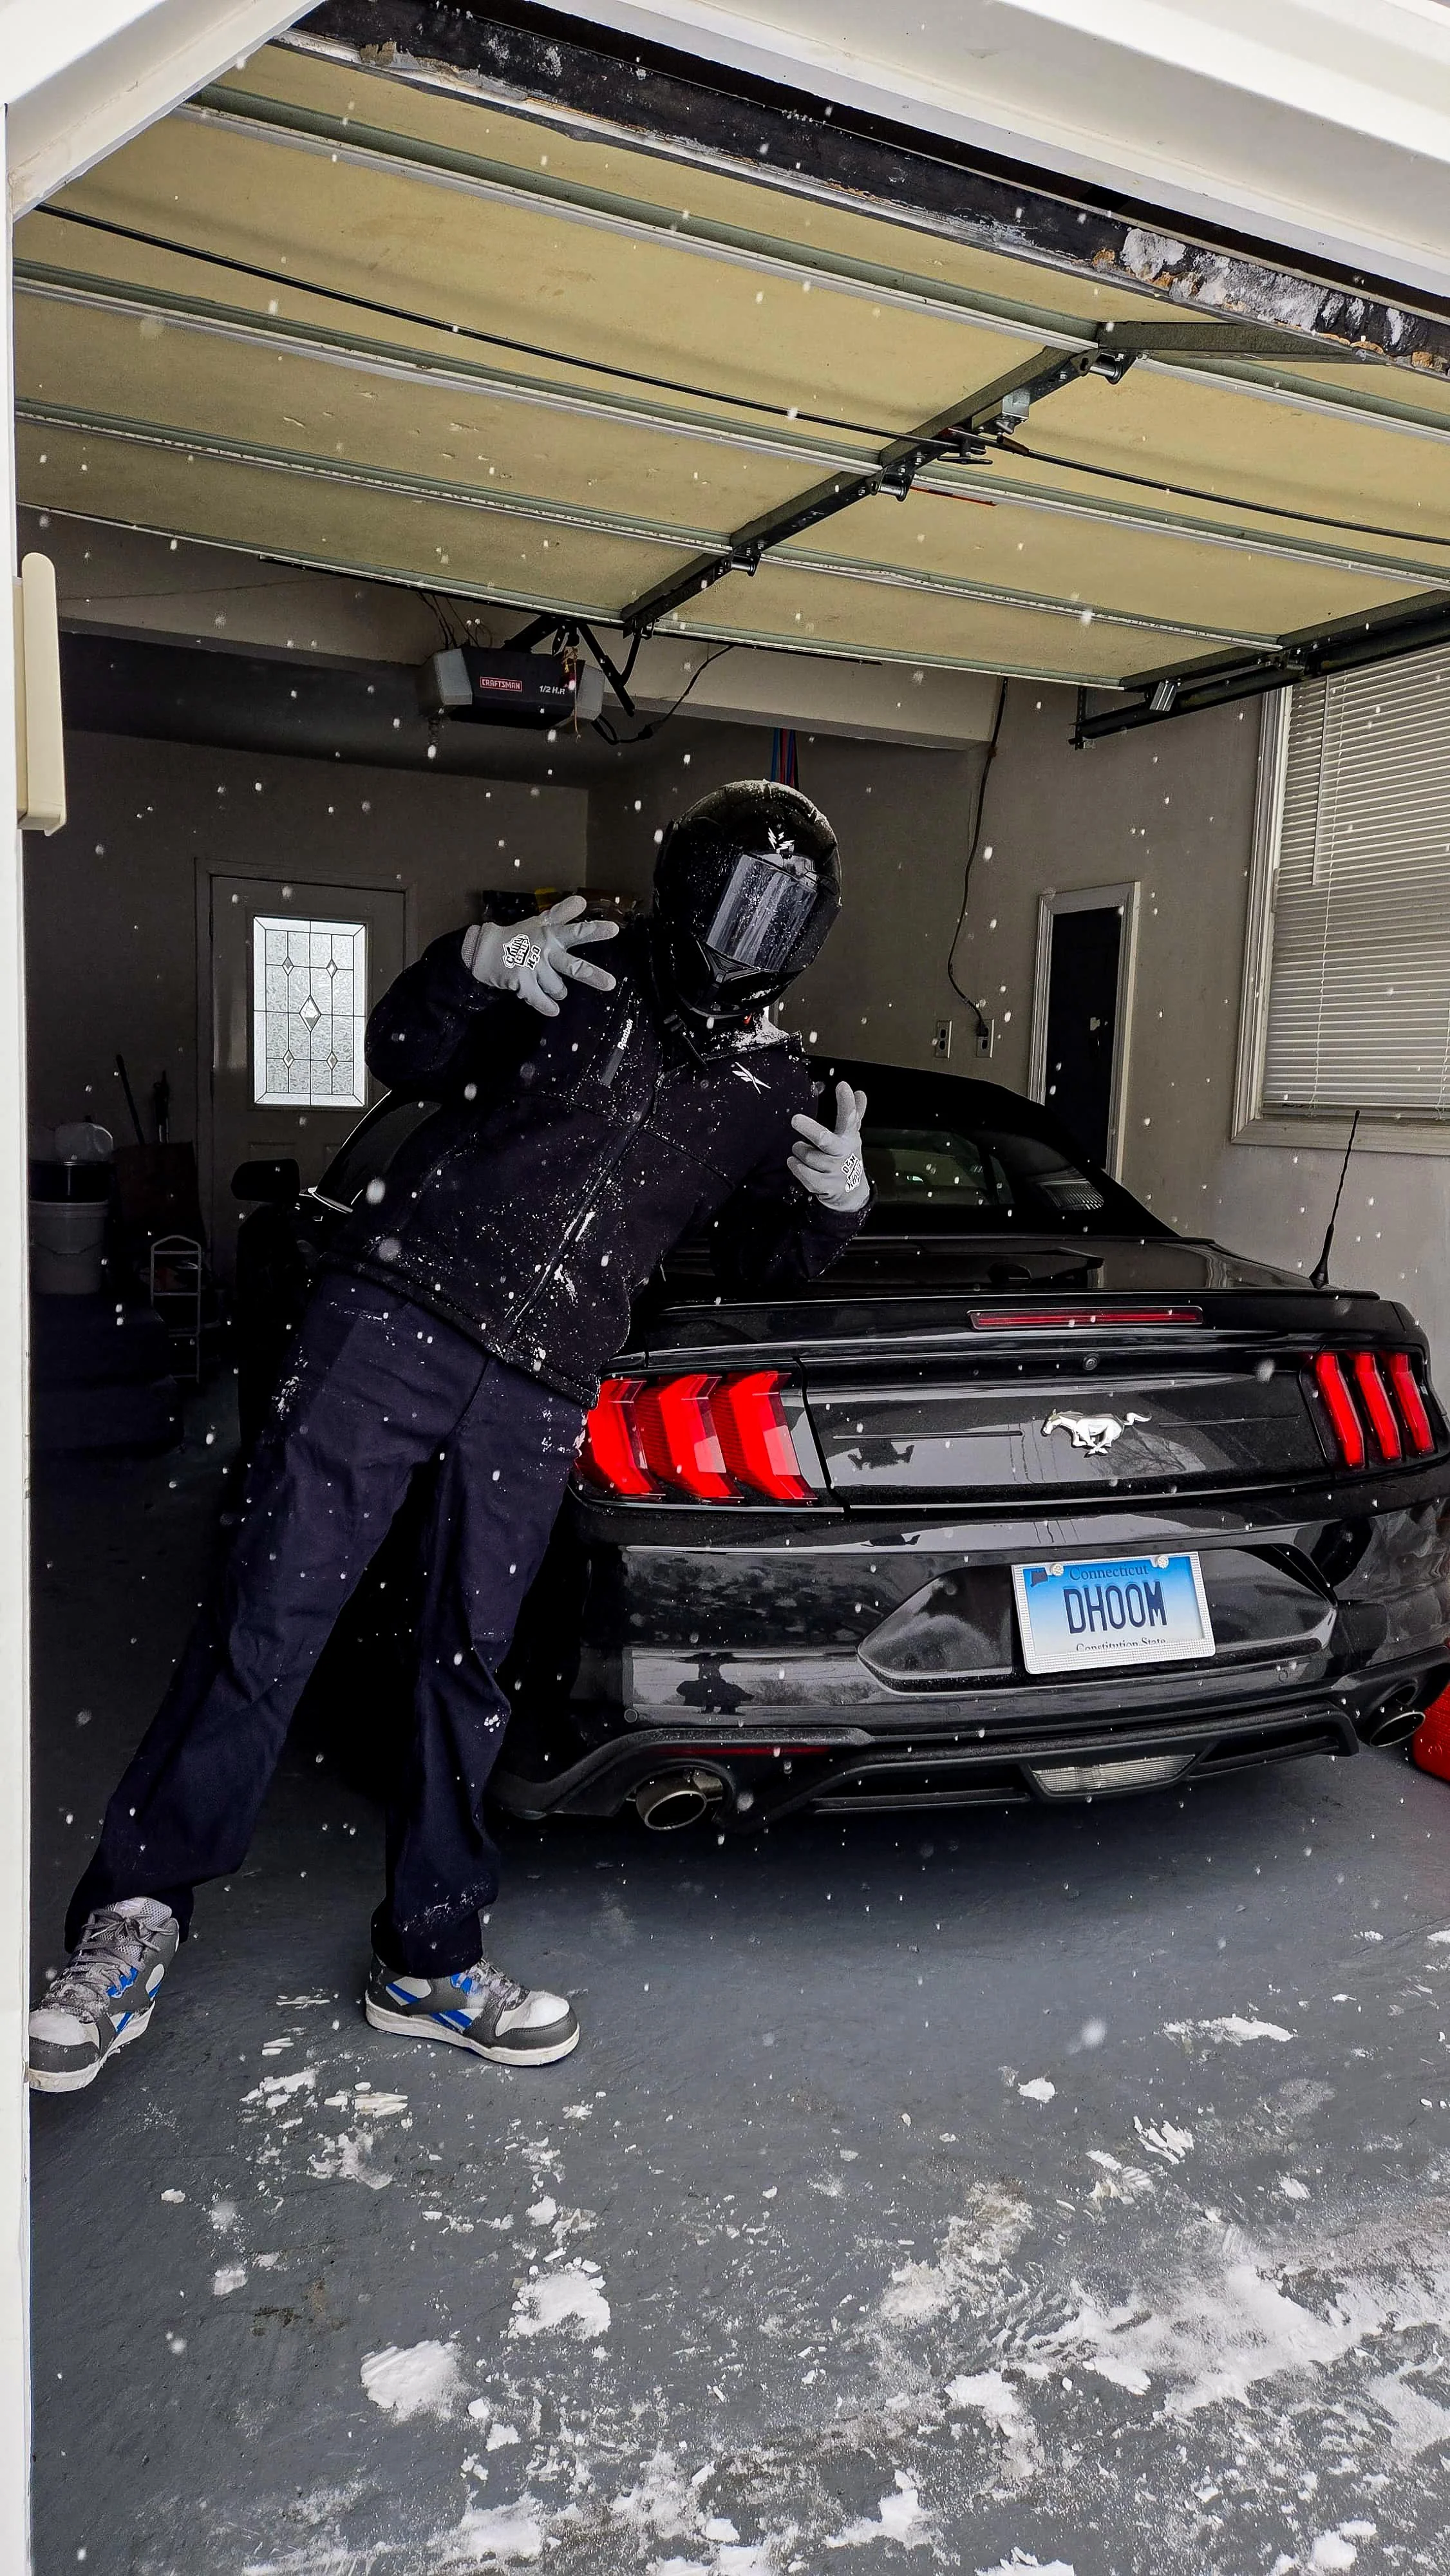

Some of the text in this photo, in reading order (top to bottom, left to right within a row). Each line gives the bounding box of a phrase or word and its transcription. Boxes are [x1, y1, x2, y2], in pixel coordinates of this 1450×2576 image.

[481, 679, 521, 690] CRAFTSMAN
[539, 685, 551, 694] 1/2
[1069, 1563, 1149, 1581] Connecticut
[1063, 1580, 1168, 1634] DHOOM
